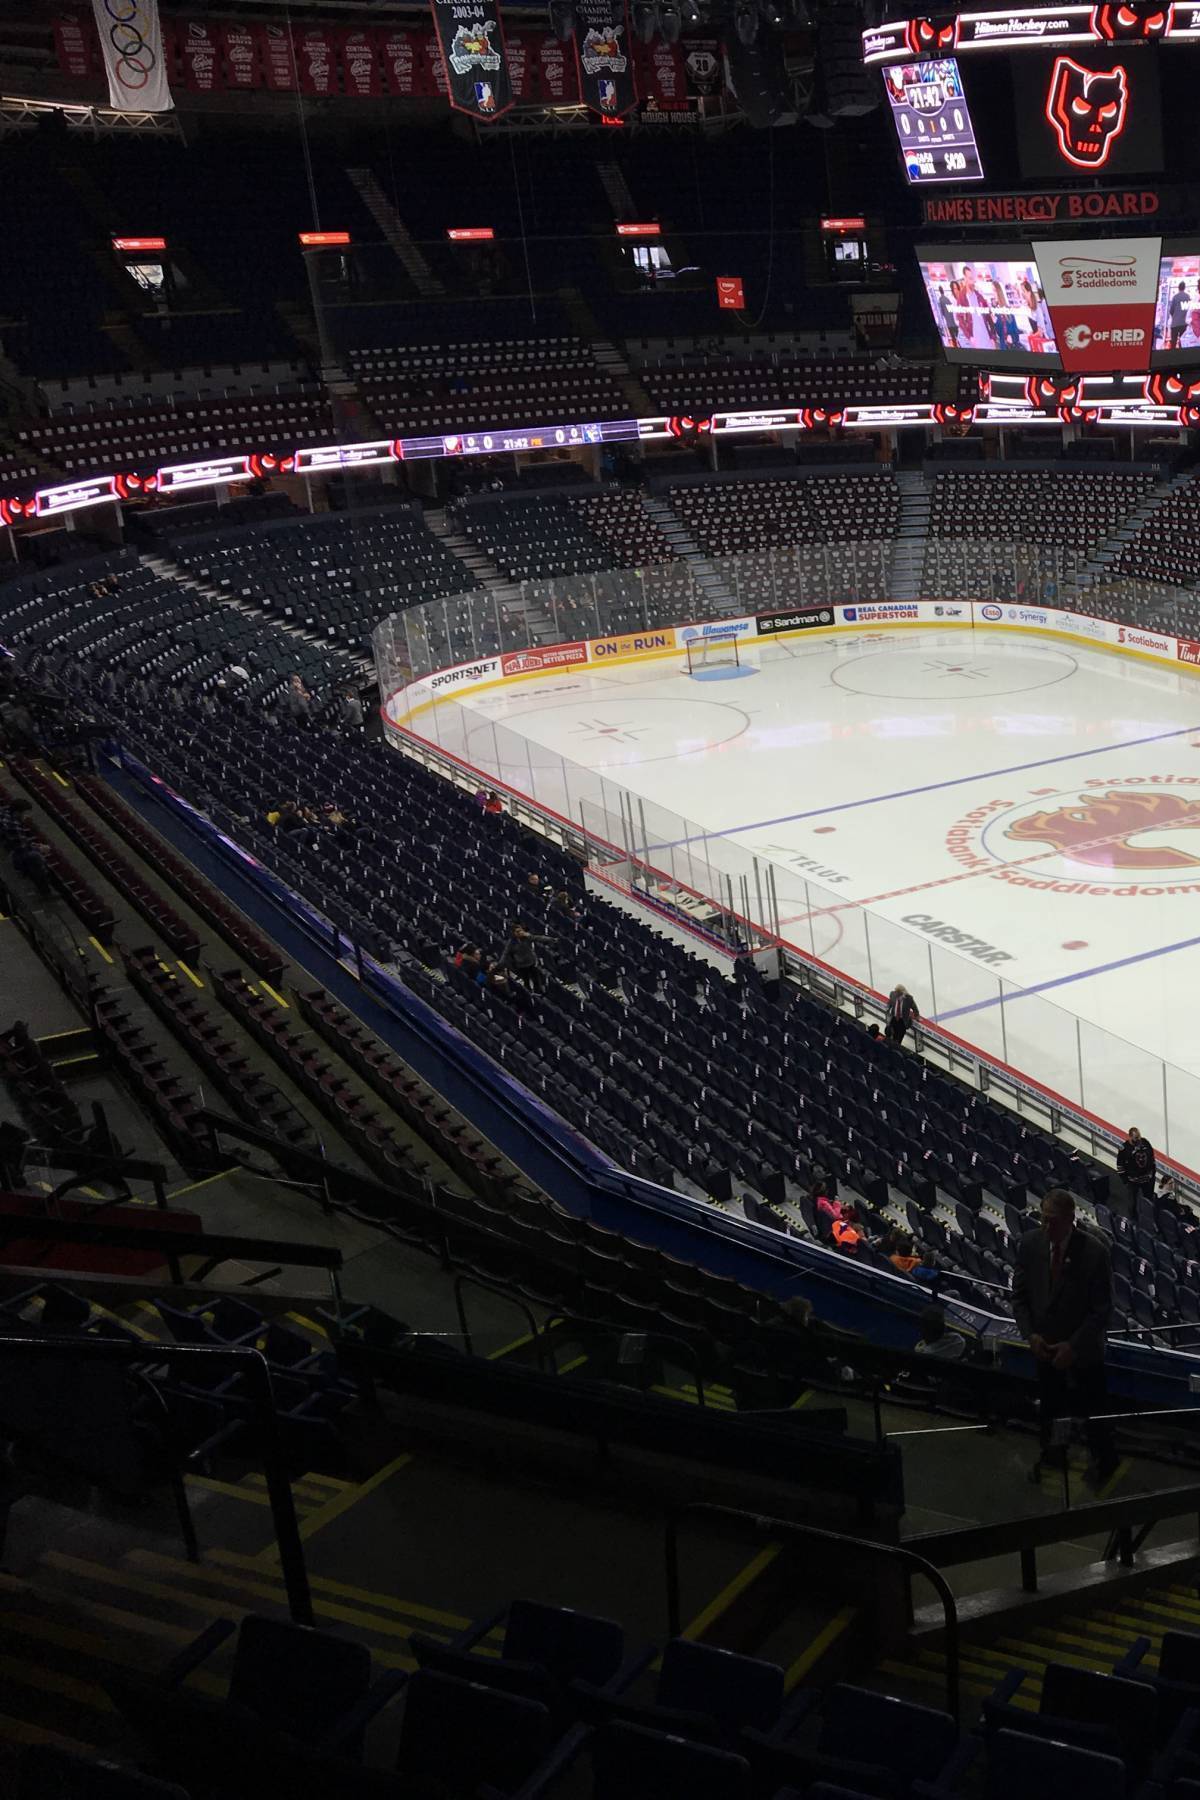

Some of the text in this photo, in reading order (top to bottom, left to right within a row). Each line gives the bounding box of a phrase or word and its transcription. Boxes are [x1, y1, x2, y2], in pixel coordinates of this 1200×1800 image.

[974, 18, 1069, 38] HitmenHockey.com
[909, 86, 942, 109] 21:42
[901, 113, 911, 135] 0
[918, 119, 925, 133] 0
[940, 117, 947, 131] 0
[953, 108, 964, 131] 0
[927, 192, 1159, 222] FLAMES ENERGY BOARD
[1076, 268, 1136, 279] Scotiabank
[1076, 278, 1137, 288] Saddledome
[1092, 331, 1110, 341] OF
[1110, 328, 1145, 342] RED
[483, 435, 493, 450] 0
[556, 429, 564, 443] 0
[858, 604, 918, 613] REAL CANADIAN
[858, 610, 919, 621] SUPERSTORE
[1020, 611, 1047, 624] Synergy
[702, 621, 749, 636] Wawanesa
[775, 614, 819, 628] Sandman
[595, 642, 618, 656] ON
[1127, 632, 1169, 651] Scotiabank
[1179, 641, 1194, 661] Tim
[431, 660, 499, 689] SPORTSNET
[945, 798, 1015, 870] Scotiabank
[789, 855, 851, 884] TELUS
